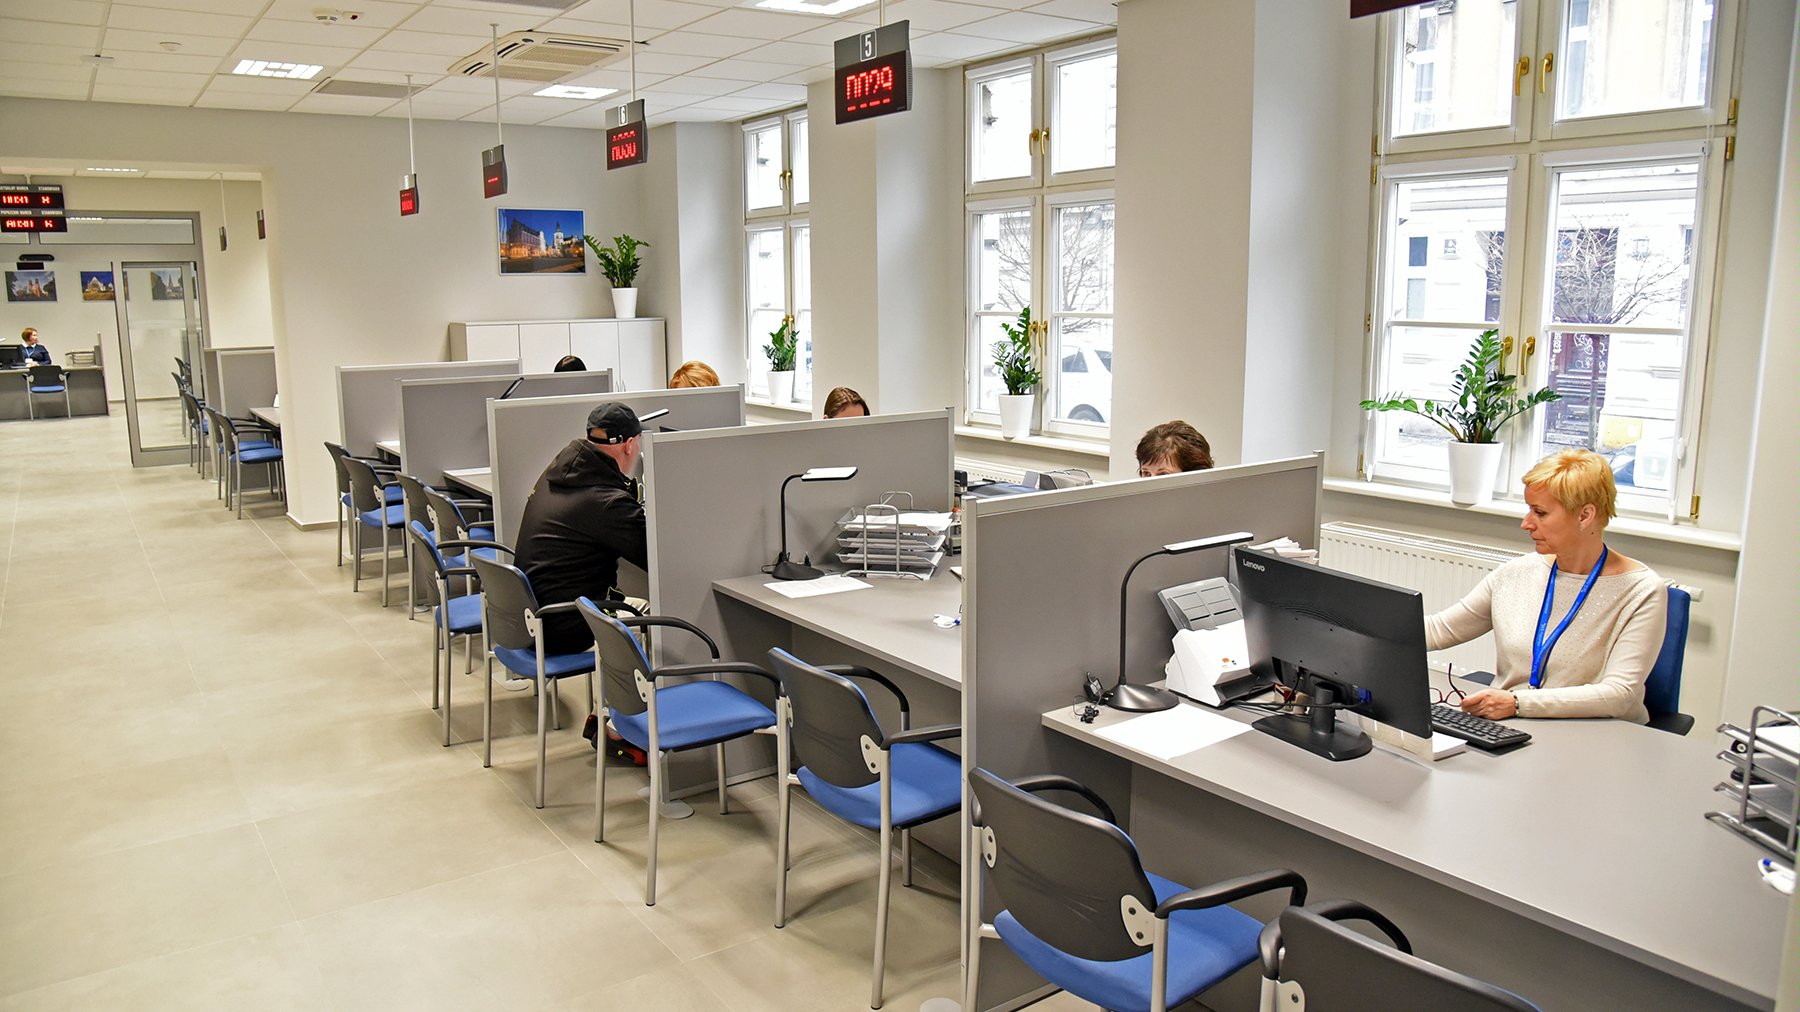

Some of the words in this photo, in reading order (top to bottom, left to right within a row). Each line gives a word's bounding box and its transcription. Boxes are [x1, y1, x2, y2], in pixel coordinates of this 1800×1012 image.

[864, 34, 872, 58] 5
[620, 106, 626, 125] 6
[1242, 558, 1266, 572] Lenovo
